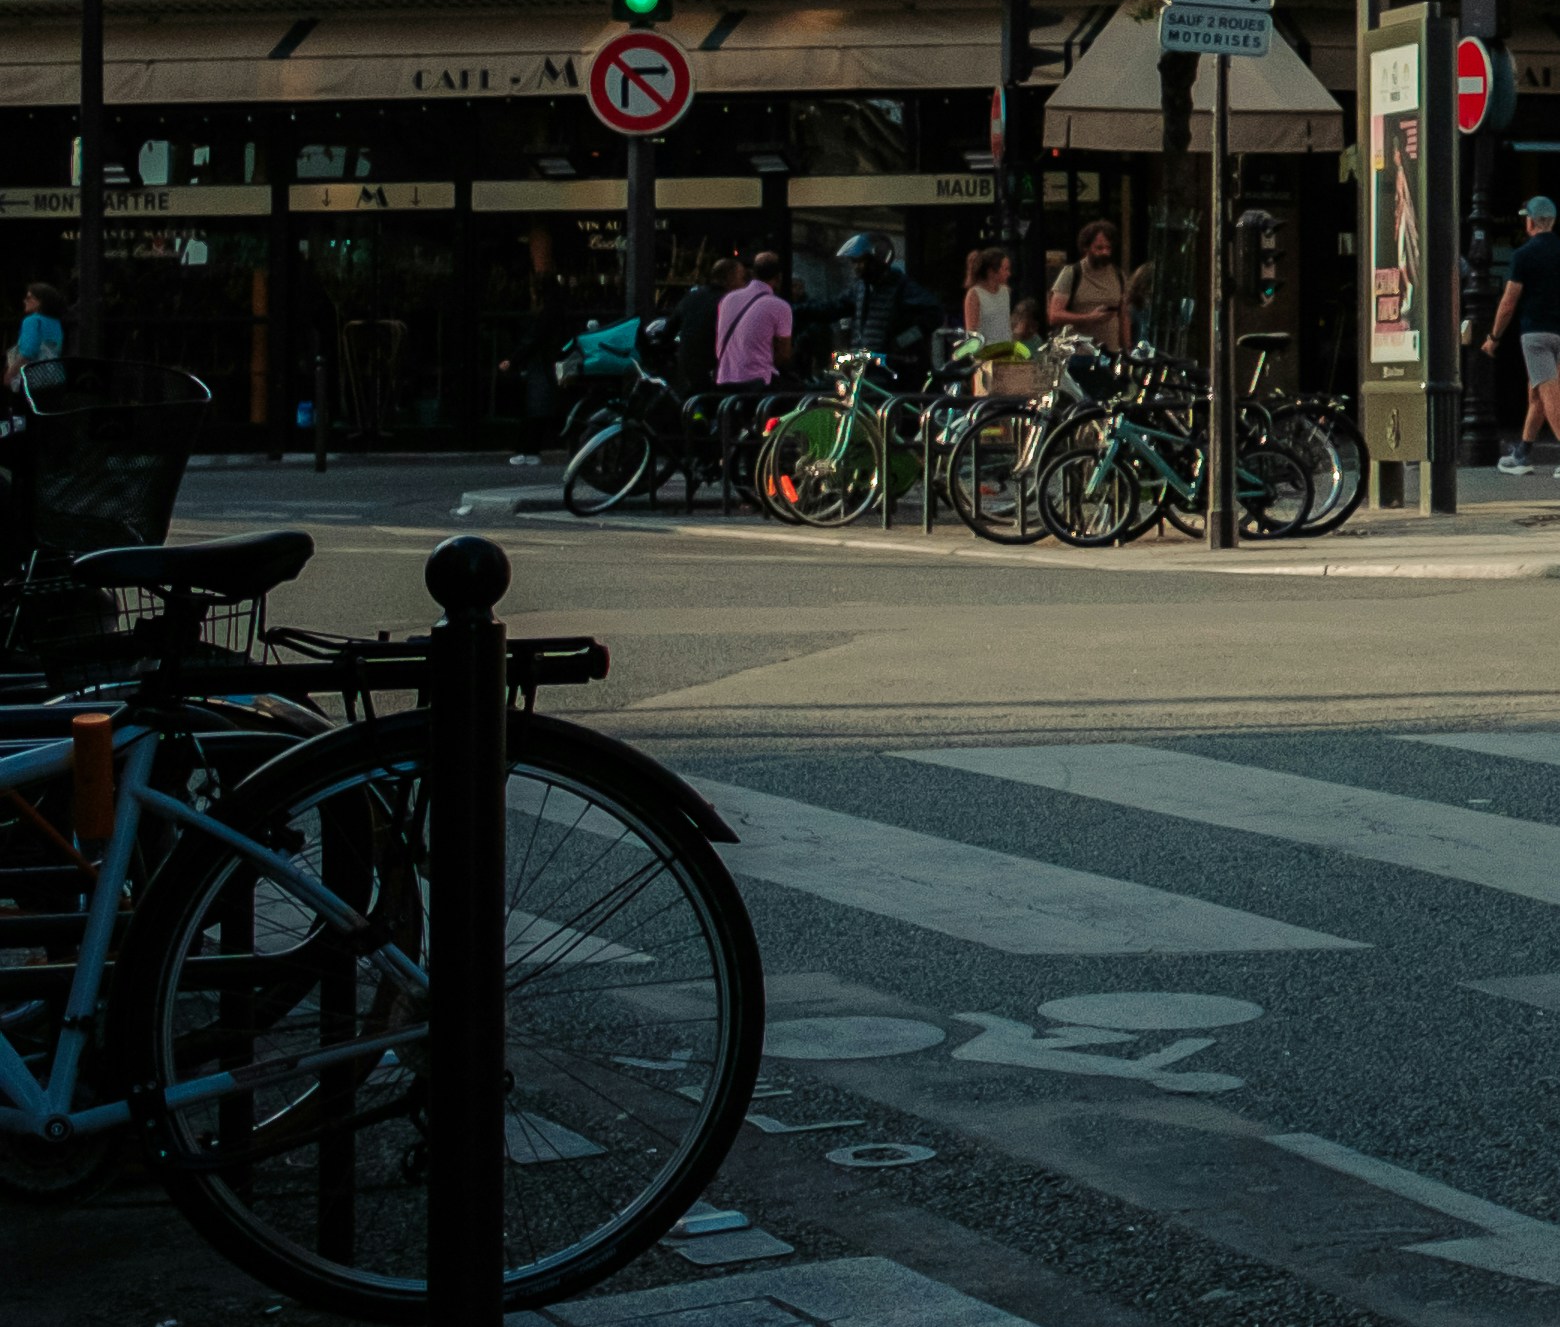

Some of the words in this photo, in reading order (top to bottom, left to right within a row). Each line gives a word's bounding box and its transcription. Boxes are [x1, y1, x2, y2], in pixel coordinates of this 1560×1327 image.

[1167, 12, 1204, 27] SAUF
[1207, 16, 1216, 28] 2
[1218, 17, 1266, 32] ROUES
[34, 191, 169, 213] MONARTRE
[357, 186, 388, 208] M
